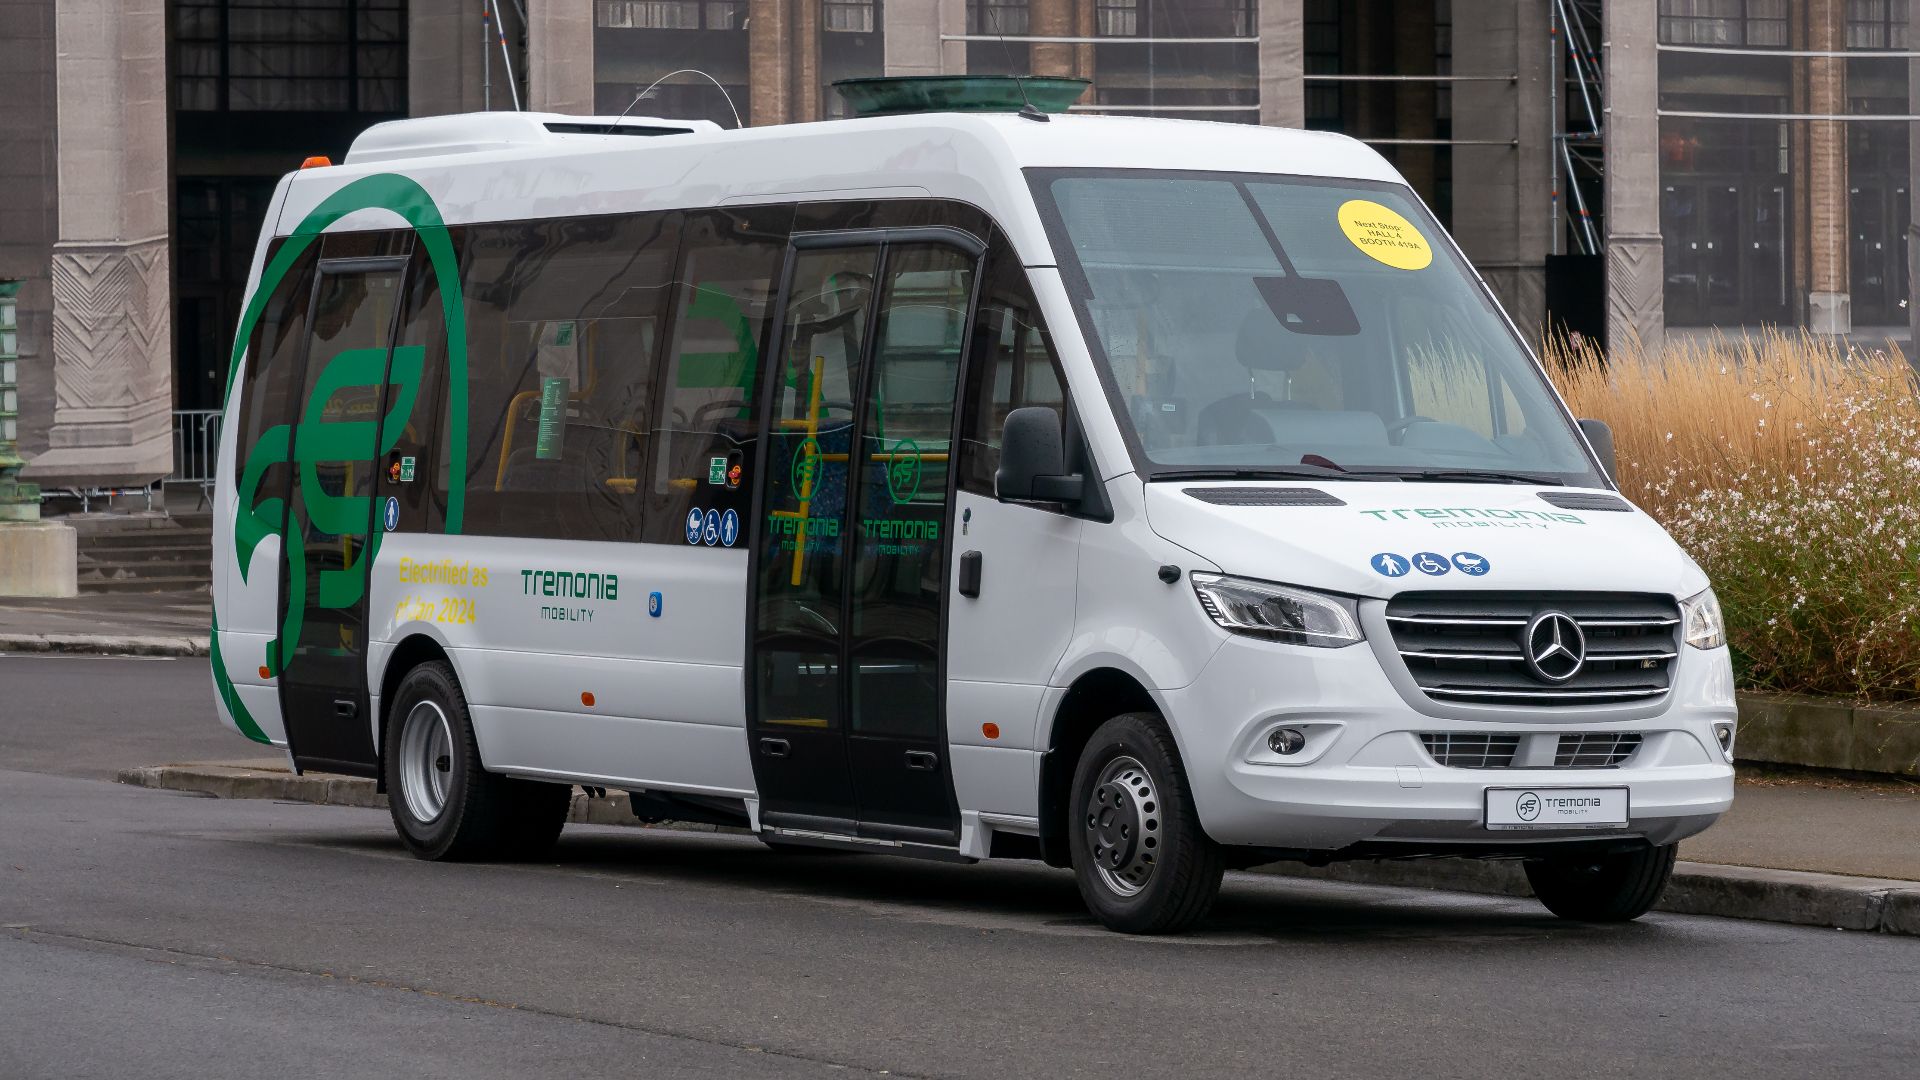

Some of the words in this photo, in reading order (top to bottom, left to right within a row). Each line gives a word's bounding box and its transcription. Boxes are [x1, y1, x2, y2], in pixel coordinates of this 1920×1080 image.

[1354, 220, 1377, 229] Next
[1367, 229, 1395, 239] HALL
[1396, 232, 1403, 240] 4
[1359, 237, 1396, 247] BOOTH
[1398, 241, 1421, 250] 419A
[399, 556, 469, 585] Electrified
[471, 566, 489, 588] as
[437, 597, 477, 625] 2024
